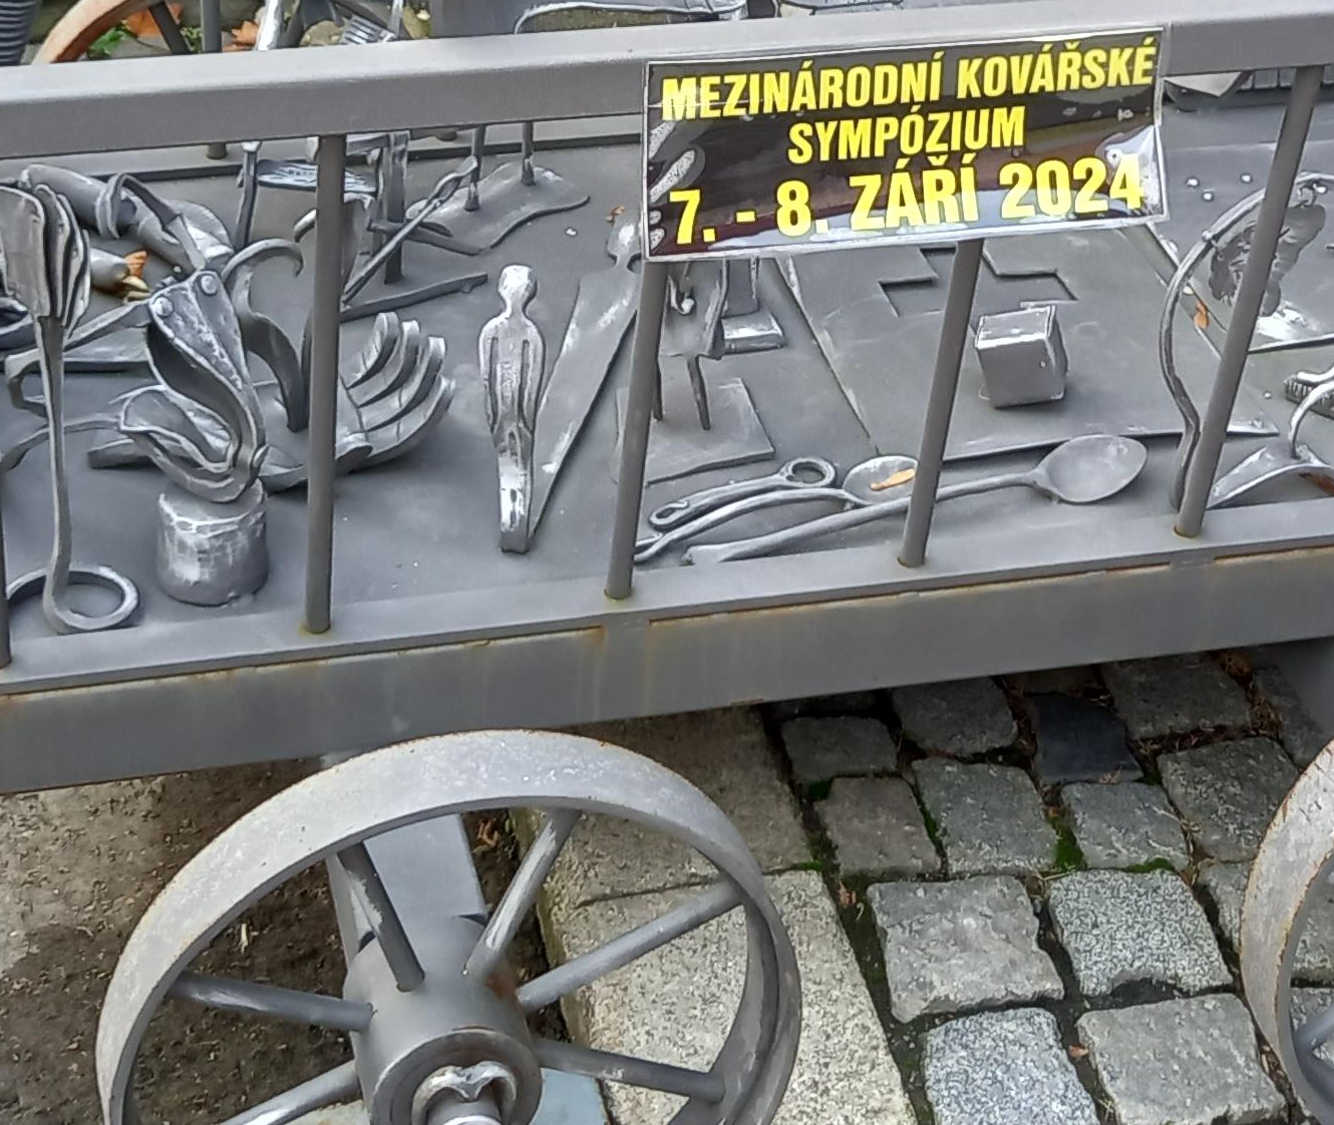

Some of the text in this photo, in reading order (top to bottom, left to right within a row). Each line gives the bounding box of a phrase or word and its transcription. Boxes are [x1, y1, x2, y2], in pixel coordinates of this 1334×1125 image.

[661, 37, 1157, 120] MEZINÁRODNÍ KOVÁŘSKÉ
[787, 105, 1026, 164] SYMPÓZIUM
[669, 189, 716, 245] 7.
[775, 180, 828, 237] 8.
[849, 154, 979, 231] ZÁŘÍ
[999, 156, 1145, 219] 2024
